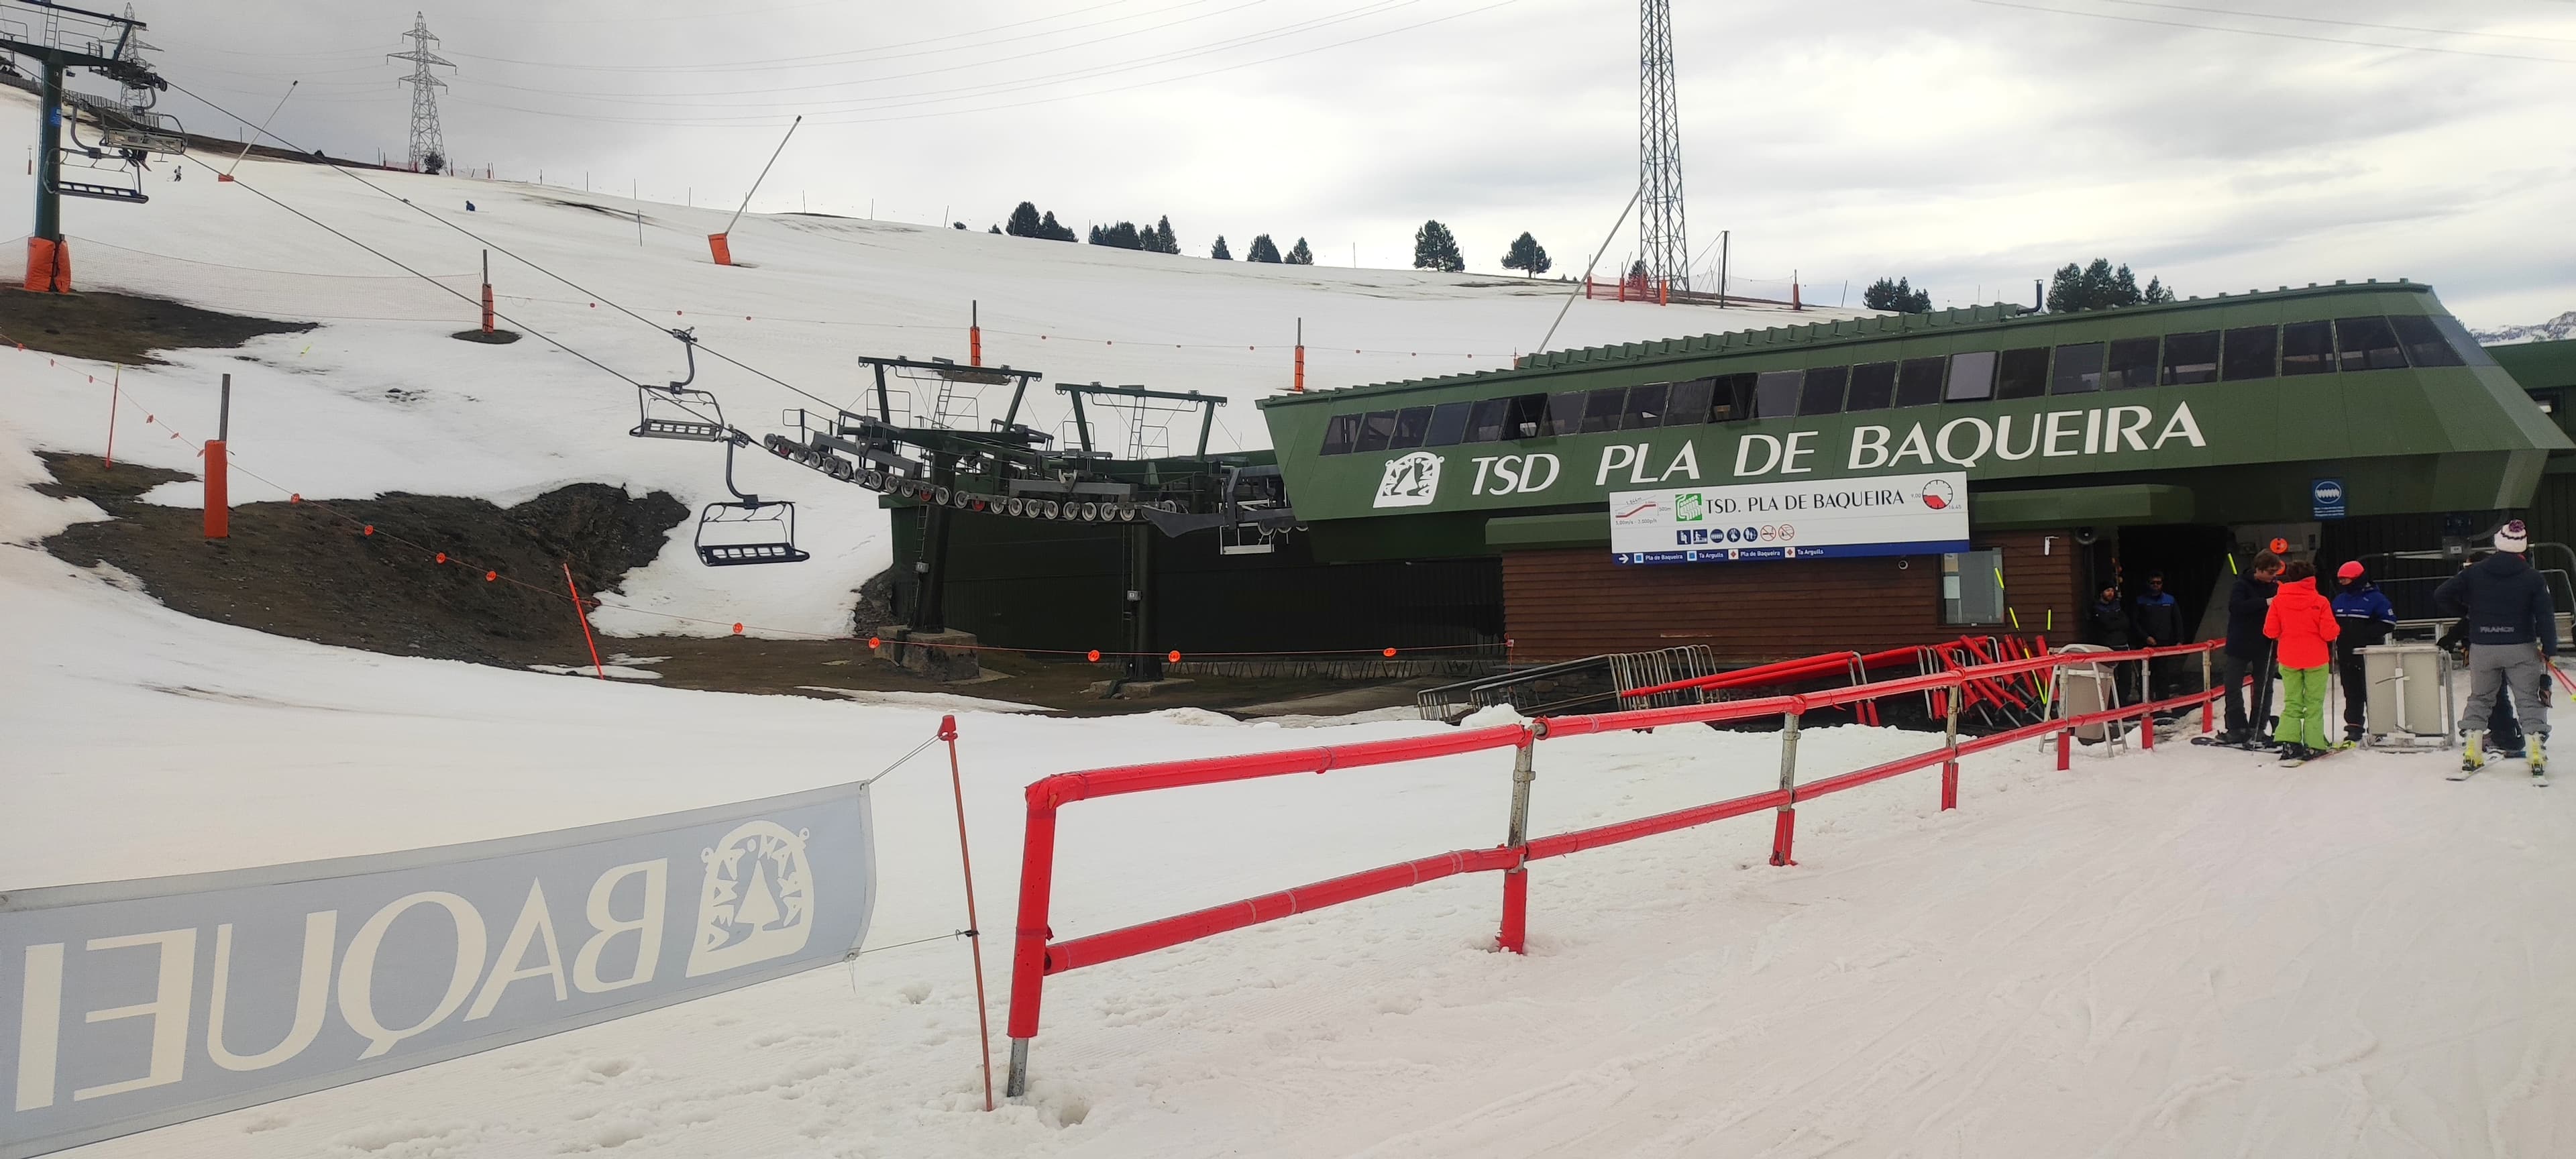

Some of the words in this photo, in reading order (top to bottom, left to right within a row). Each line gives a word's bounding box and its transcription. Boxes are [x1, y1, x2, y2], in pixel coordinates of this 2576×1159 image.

[1471, 453, 1560, 496] TSD
[1595, 439, 1700, 486] PLA
[1733, 431, 1819, 478] DE
[1847, 400, 2207, 470] BAQUEIRA
[1705, 498, 1741, 514] TSD.
[1748, 496, 1778, 512] PLA
[1784, 494, 1808, 510] DE
[1813, 489, 1904, 509] BAQUEIRA
